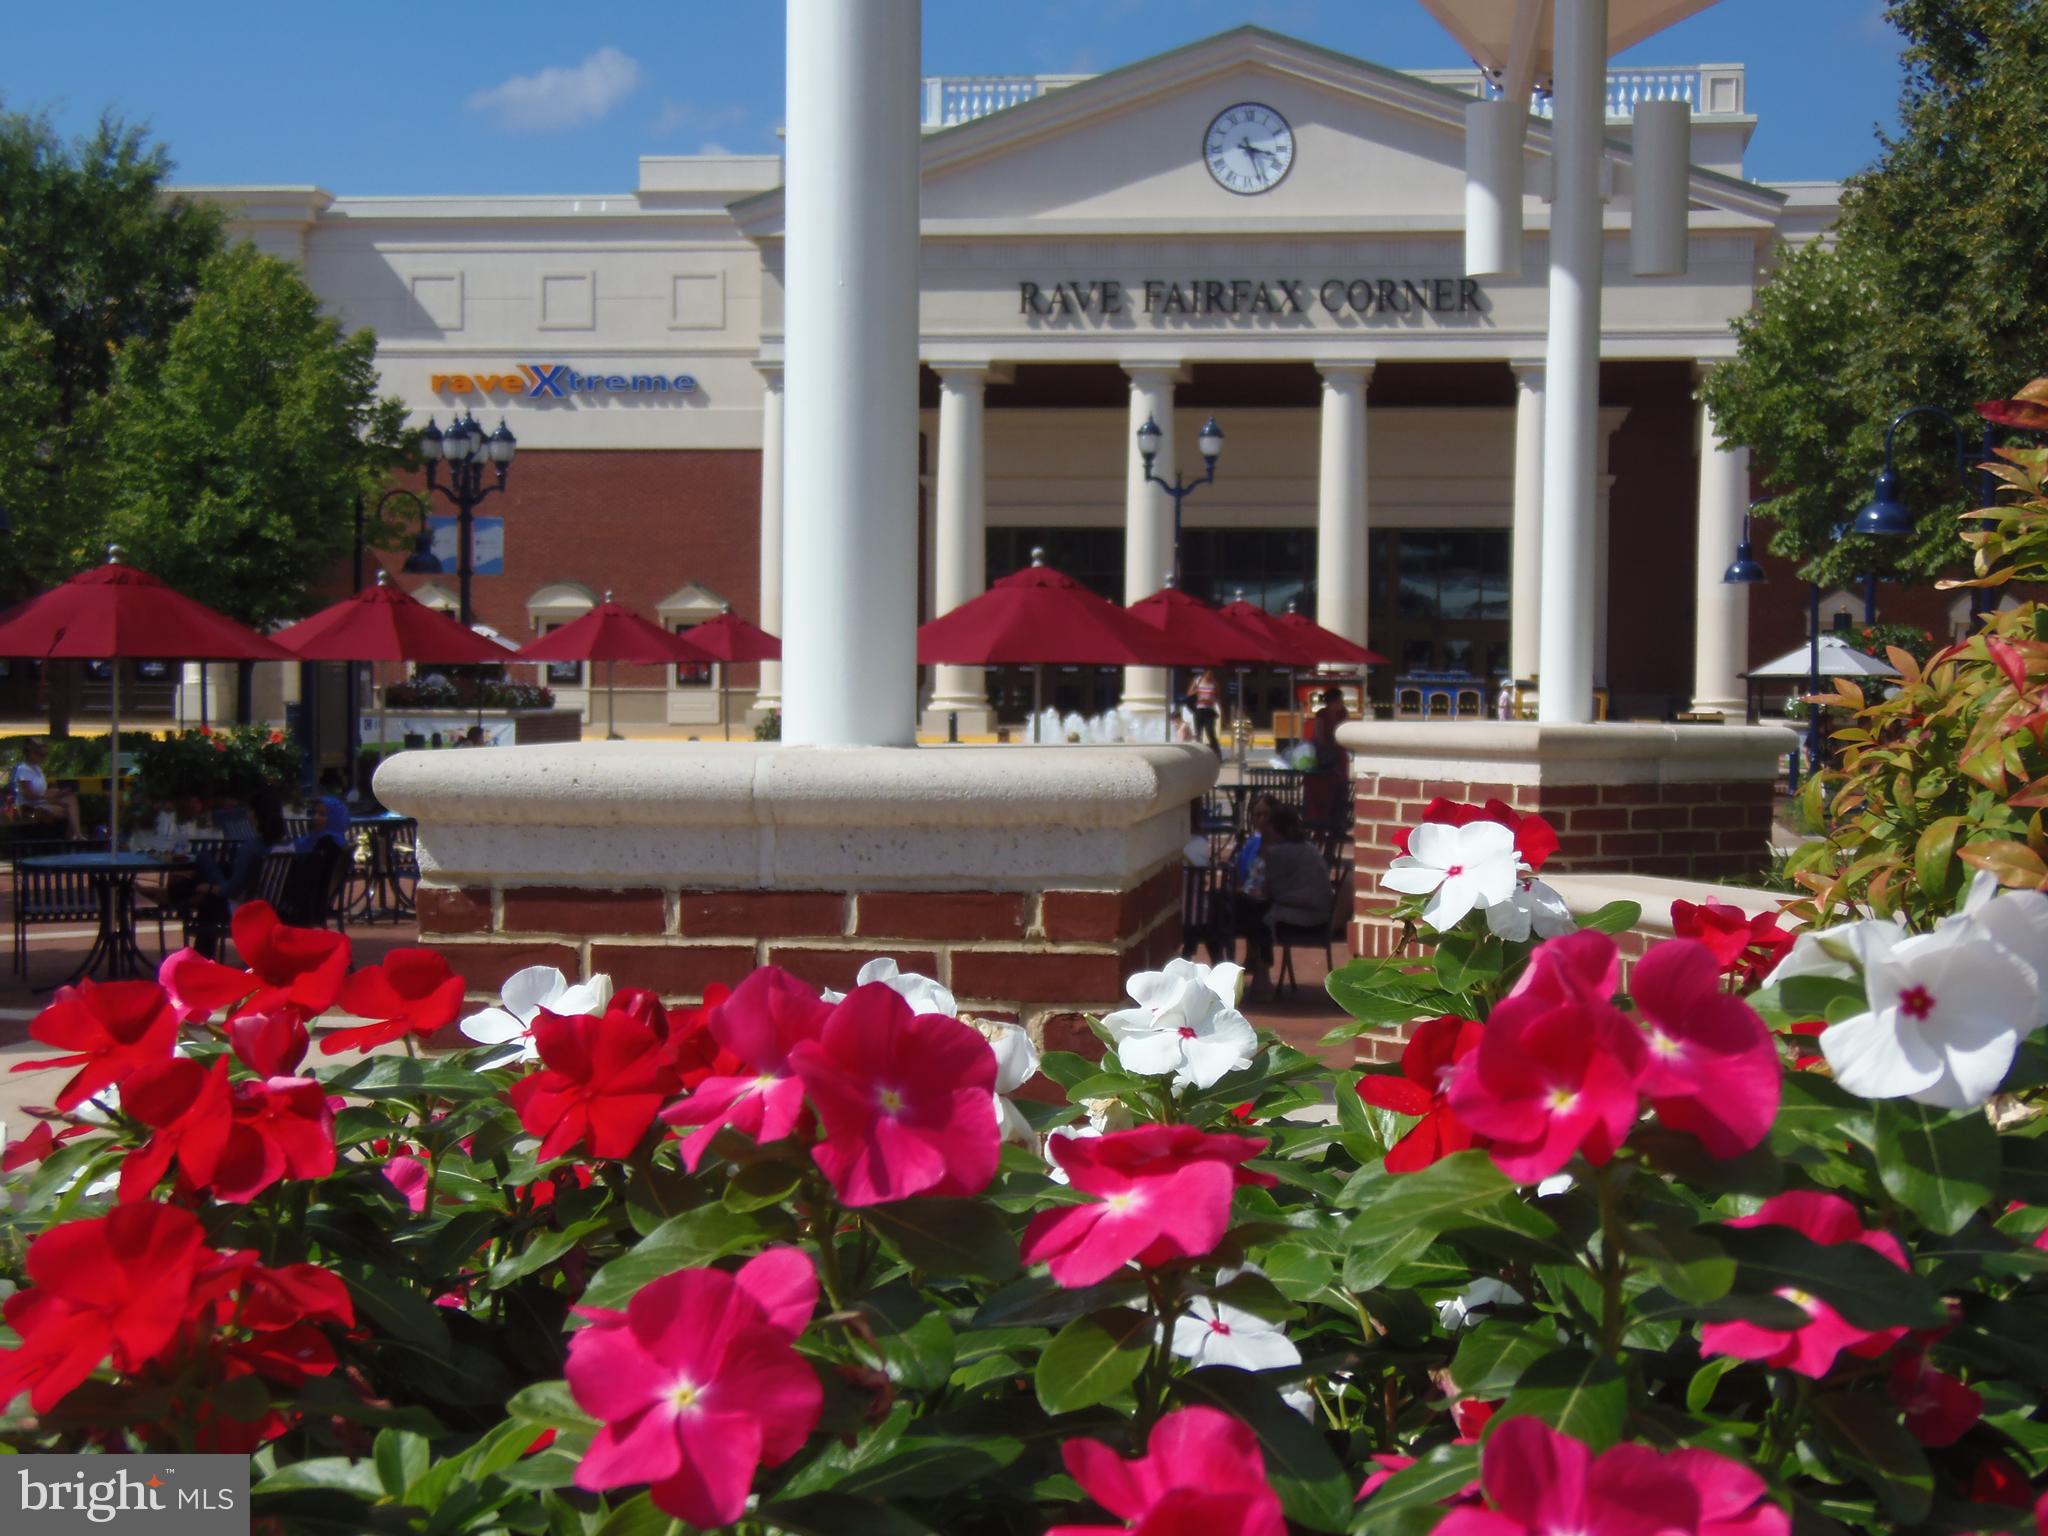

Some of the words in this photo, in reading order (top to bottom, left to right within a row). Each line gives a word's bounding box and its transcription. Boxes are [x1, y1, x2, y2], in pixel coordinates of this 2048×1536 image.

[1018, 280, 1123, 314] RAVE
[1143, 280, 1303, 314] FAIRFAX
[1320, 278, 1484, 313] CORNER
